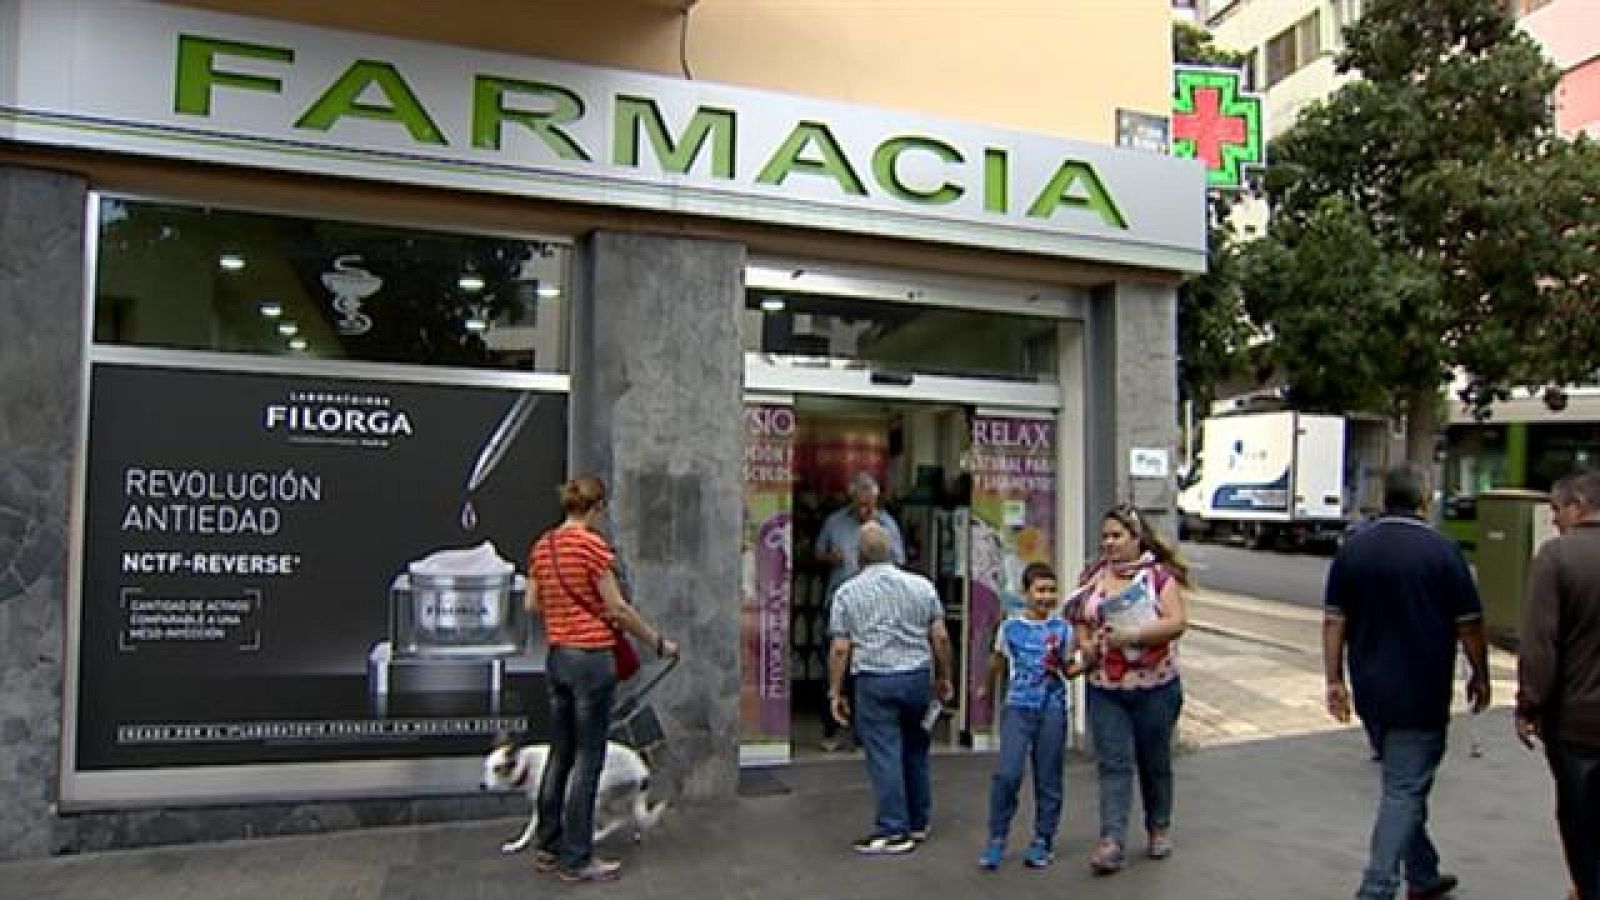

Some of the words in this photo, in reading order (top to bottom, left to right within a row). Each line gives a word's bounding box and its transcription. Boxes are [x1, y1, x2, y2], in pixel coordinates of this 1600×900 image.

[173, 33, 1130, 229] FARMACIA
[266, 405, 413, 436] FILORGA
[973, 419, 1051, 448] RELAX
[126, 468, 322, 501] REVOLUCIÓN
[121, 504, 281, 536] ANTIEDAD
